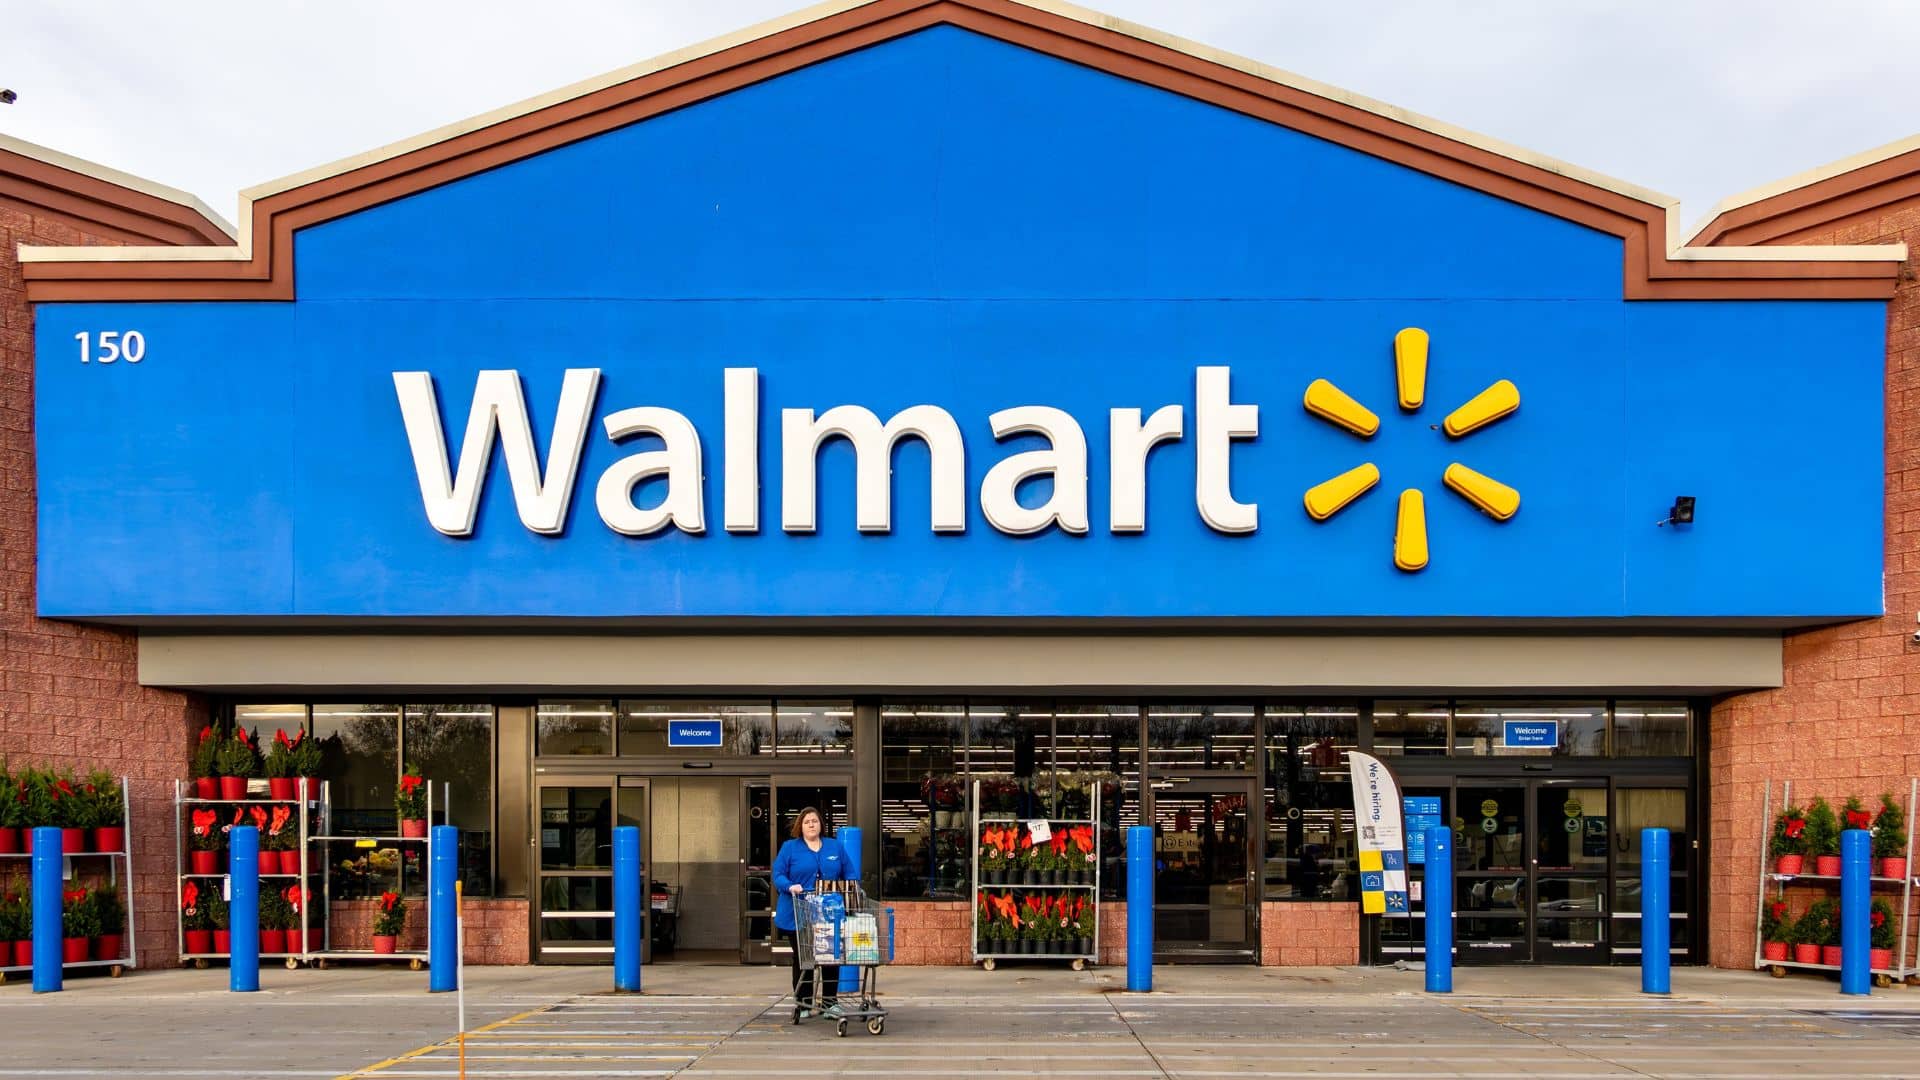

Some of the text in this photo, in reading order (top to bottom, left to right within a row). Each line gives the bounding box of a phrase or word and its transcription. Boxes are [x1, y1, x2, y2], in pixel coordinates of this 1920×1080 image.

[75, 330, 145, 363] 150
[392, 366, 1259, 537] Walmart
[679, 729, 712, 737] Welcome
[1514, 727, 1547, 735] Welcome
[1368, 762, 1382, 823] We're hiring.
